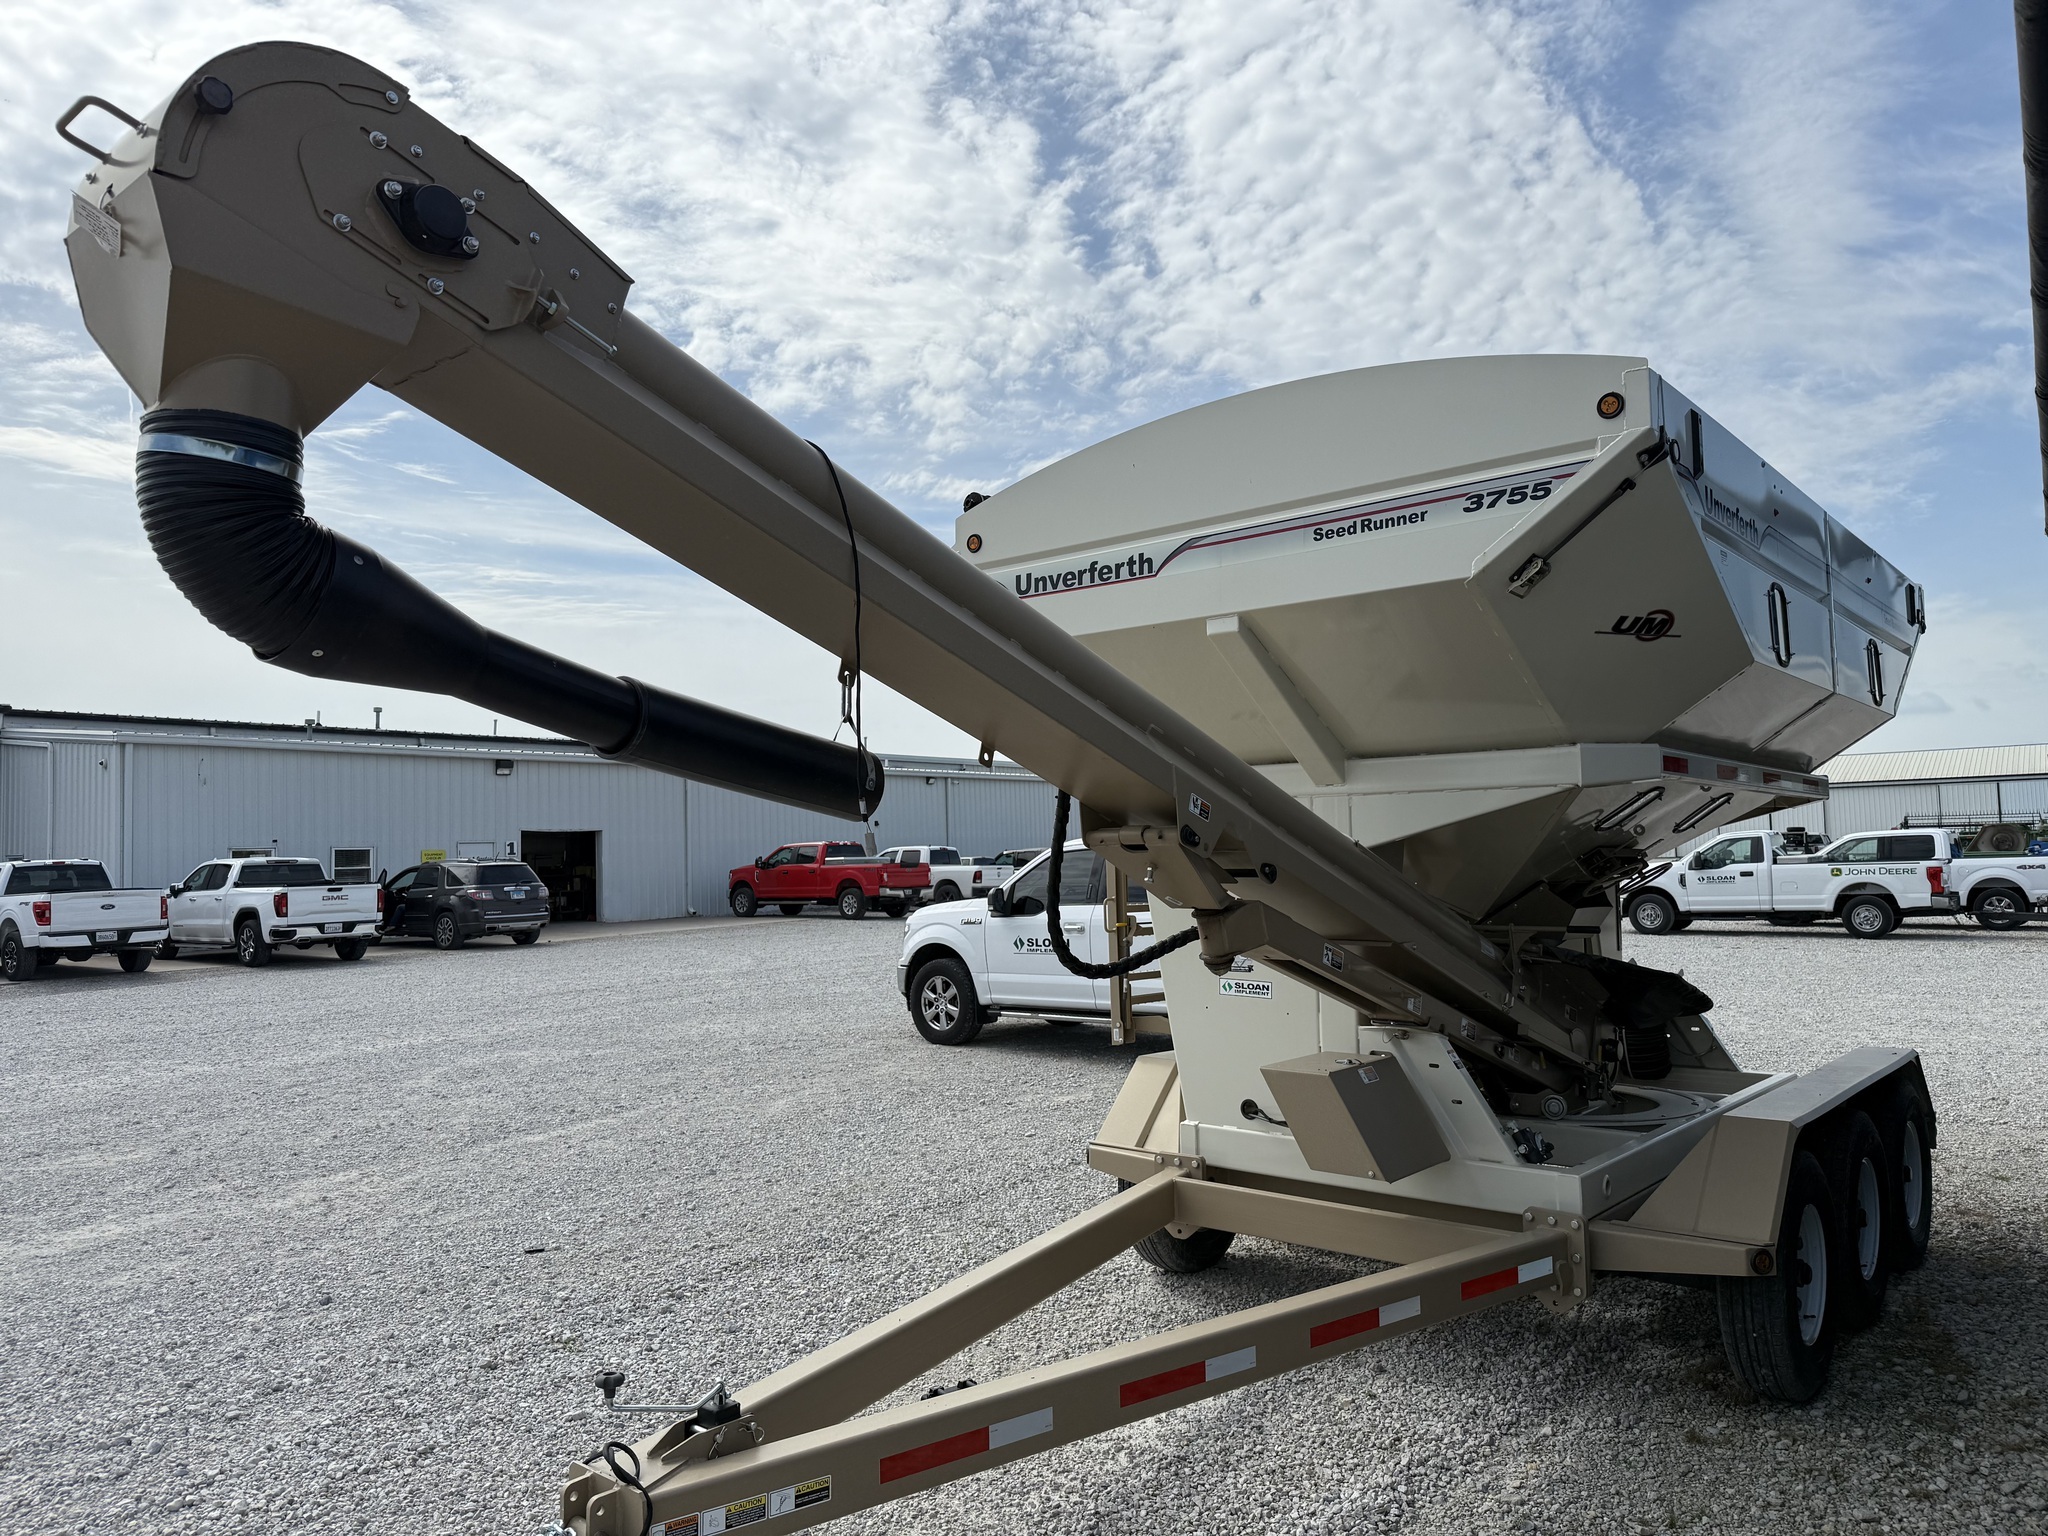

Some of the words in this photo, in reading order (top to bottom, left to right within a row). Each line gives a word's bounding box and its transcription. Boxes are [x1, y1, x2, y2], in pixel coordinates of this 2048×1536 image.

[1313, 520, 1358, 542] Seed
[1360, 509, 1429, 534] Runner
[1462, 480, 1553, 513] 3755
[1705, 485, 1759, 546] Unverferth
[1015, 552, 1154, 596] Unverferth
[507, 842, 517, 855] 1
[1845, 868, 1876, 876] JOHN
[1879, 867, 1918, 875] DEERE
[1234, 982, 1270, 991] SLOAN
[801, 1479, 829, 1492] CAUTION
[733, 1497, 763, 1511] CAUTION
[672, 1515, 697, 1528] WARNING
